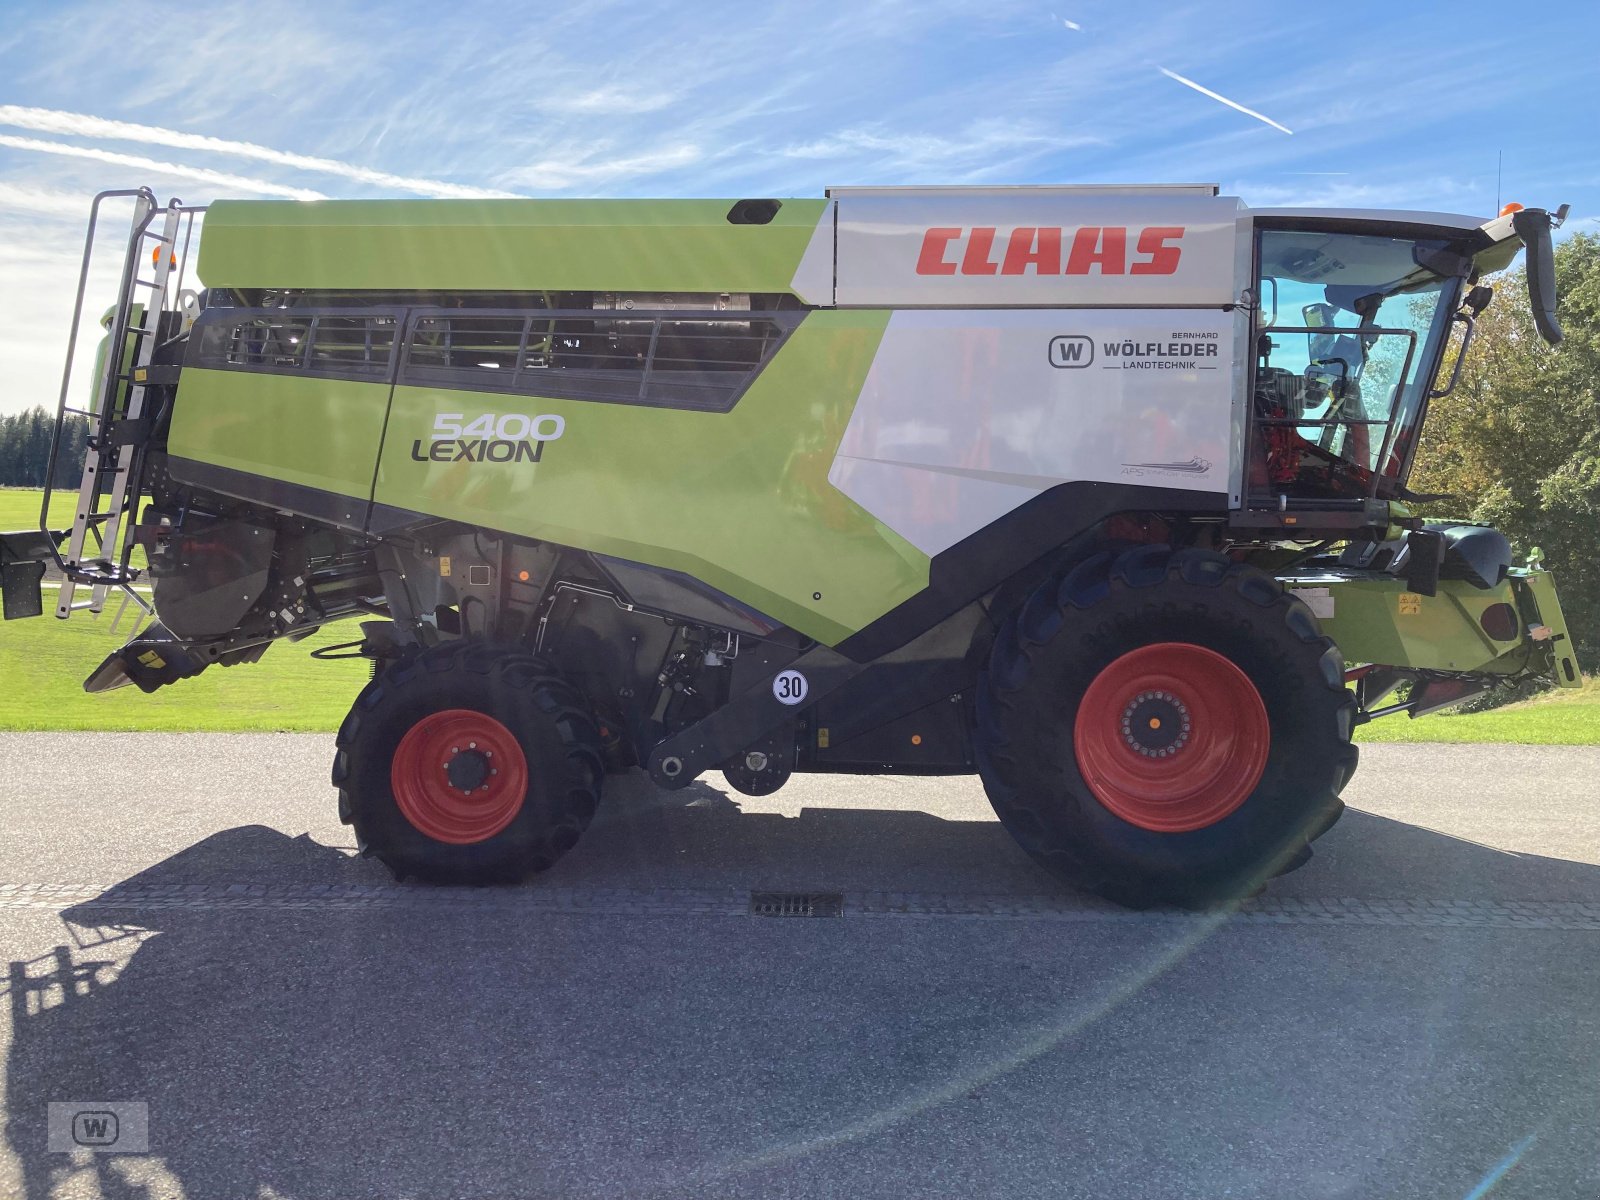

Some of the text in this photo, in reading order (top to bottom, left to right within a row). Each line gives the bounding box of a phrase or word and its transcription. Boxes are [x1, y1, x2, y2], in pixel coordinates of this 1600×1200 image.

[916, 227, 1185, 275] CLAAS
[1060, 343, 1083, 361] W
[1104, 339, 1218, 357] WÖLFLEDER
[1123, 361, 1196, 370] LANDTECHNIK
[432, 413, 566, 441] 5400
[411, 440, 543, 462] LEXION
[778, 676, 802, 698] 30
